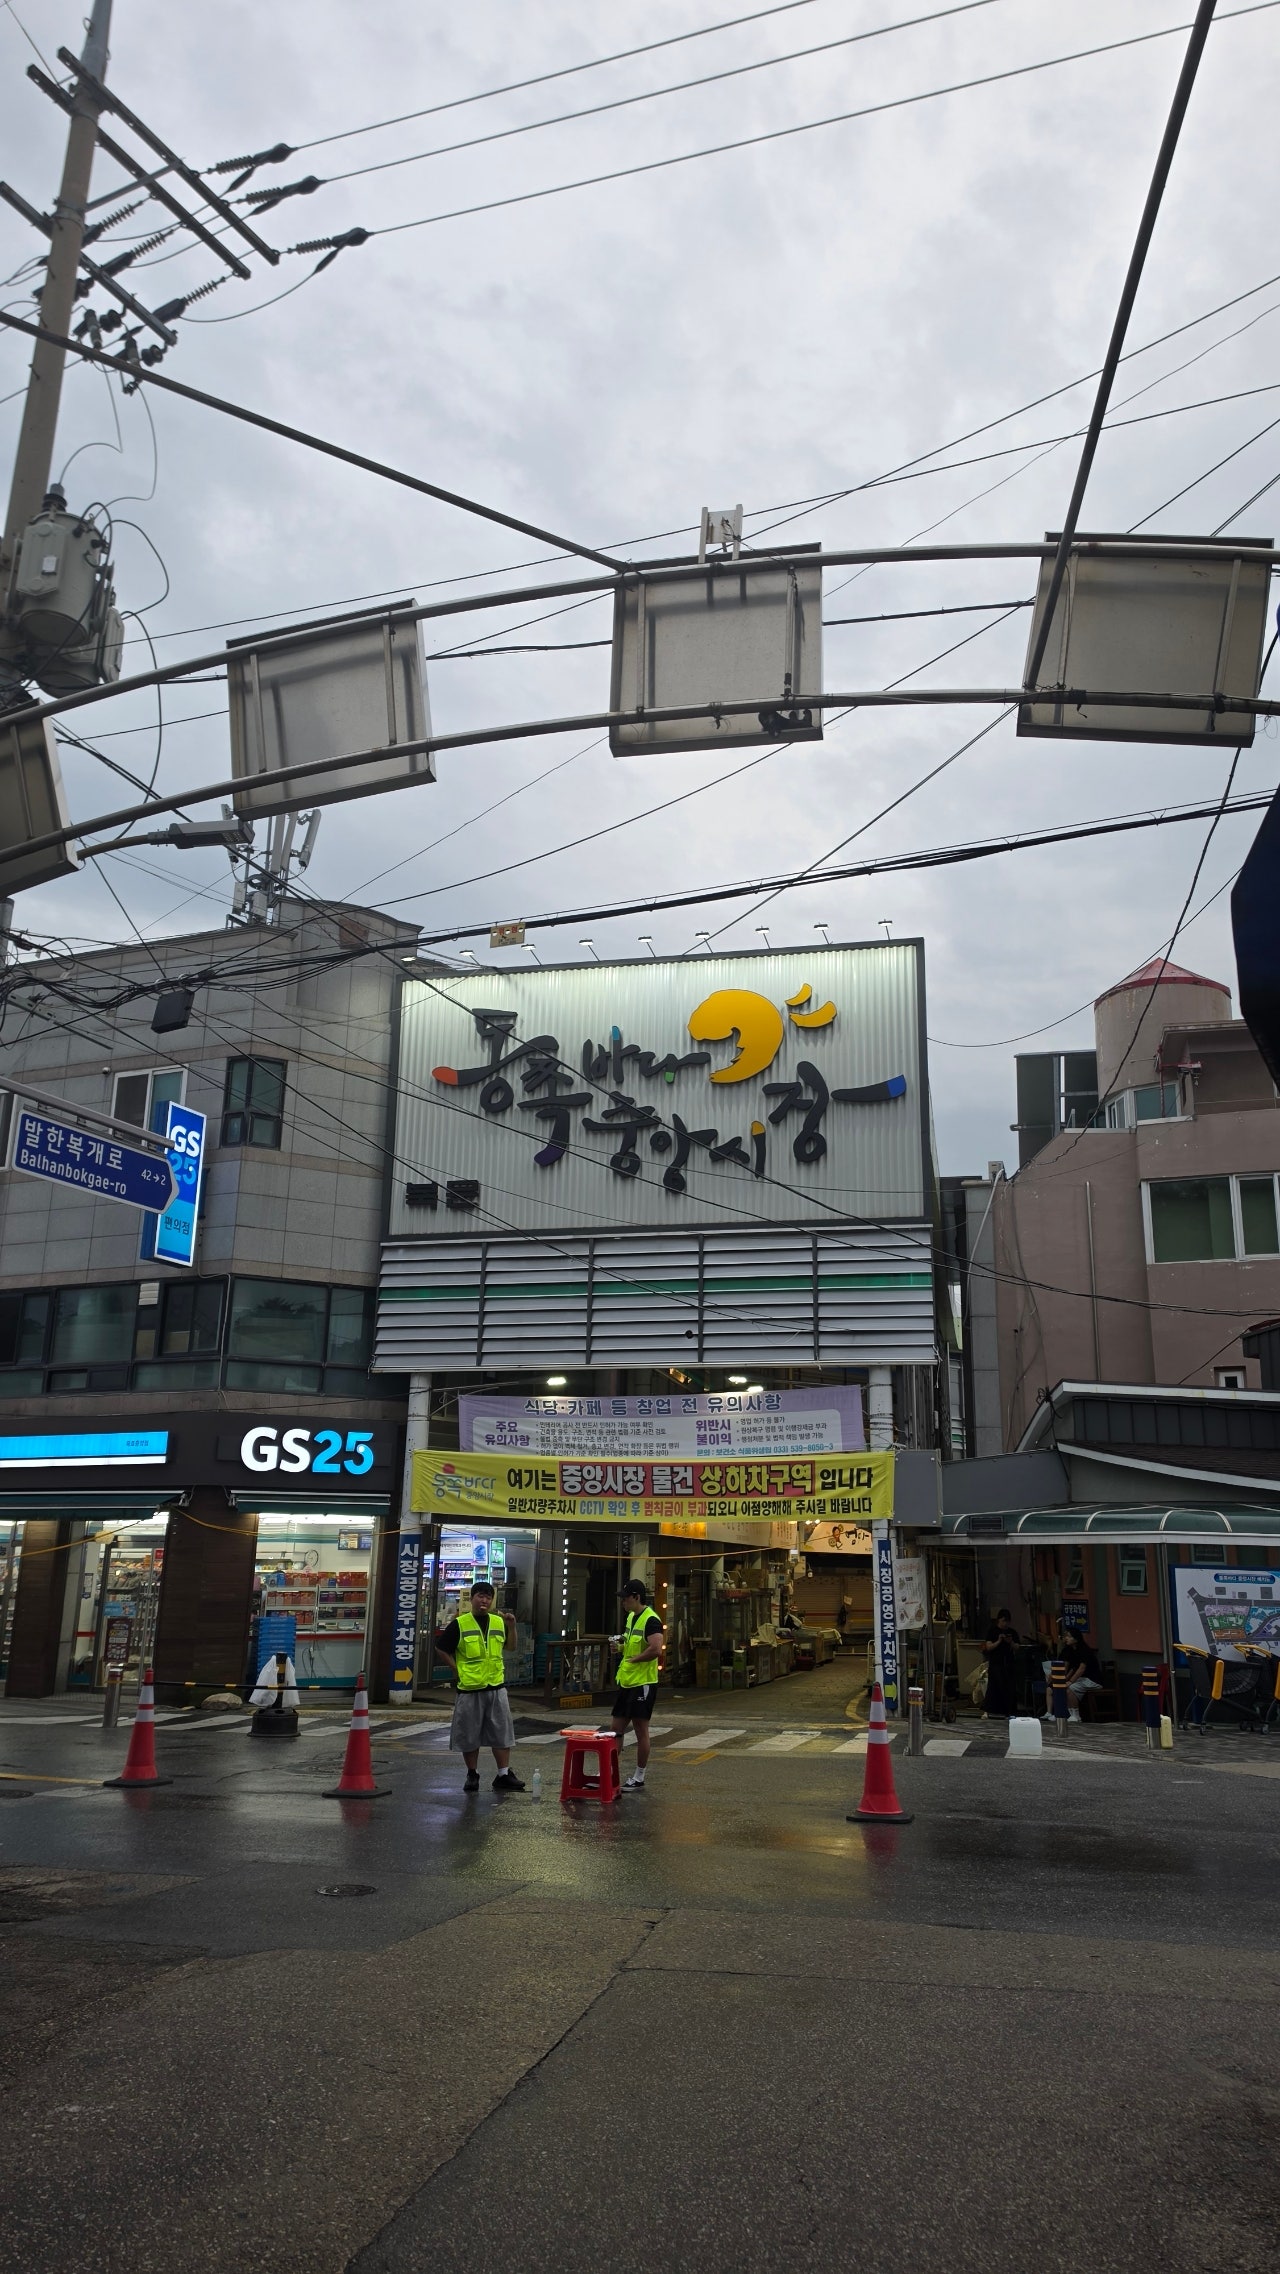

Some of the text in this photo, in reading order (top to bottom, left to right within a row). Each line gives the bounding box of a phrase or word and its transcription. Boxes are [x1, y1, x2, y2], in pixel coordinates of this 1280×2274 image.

[431, 1007, 711, 1166] 동쪽바다
[170, 1125, 201, 1157] GS
[582, 1061, 907, 1193] 중앙시장
[24, 1118, 123, 1171] 발한복개로
[20, 1148, 127, 1196] Balhanbokgae-ro
[164, 1215, 190, 1235] 편의점
[524, 1393, 782, 1416] 식당·카페 등 창업 전 유의사항
[484, 1433, 530, 1447] 유의사항
[495, 1420, 518, 1433] 주요
[695, 1419, 732, 1432] 위반시
[696, 1432, 732, 1446] 불이익
[240, 1426, 374, 1475] GS25
[506, 1463, 873, 1497] 여기는 중앙시장 물건 상,하차구역 입니다
[507, 1497, 577, 1515] 일반차량주차시
[579, 1500, 605, 1515] CCTV
[607, 1500, 628, 1516] 확인
[631, 1501, 641, 1516] 후
[644, 1501, 683, 1516] 범칙금이
[687, 1500, 737, 1517] 부과되오니
[796, 1498, 826, 1515] 주시길
[830, 1496, 873, 1514] 바랍니다
[395, 1543, 419, 1660] 시장공영주차장
[880, 1550, 897, 1676] 시장공영주차장
